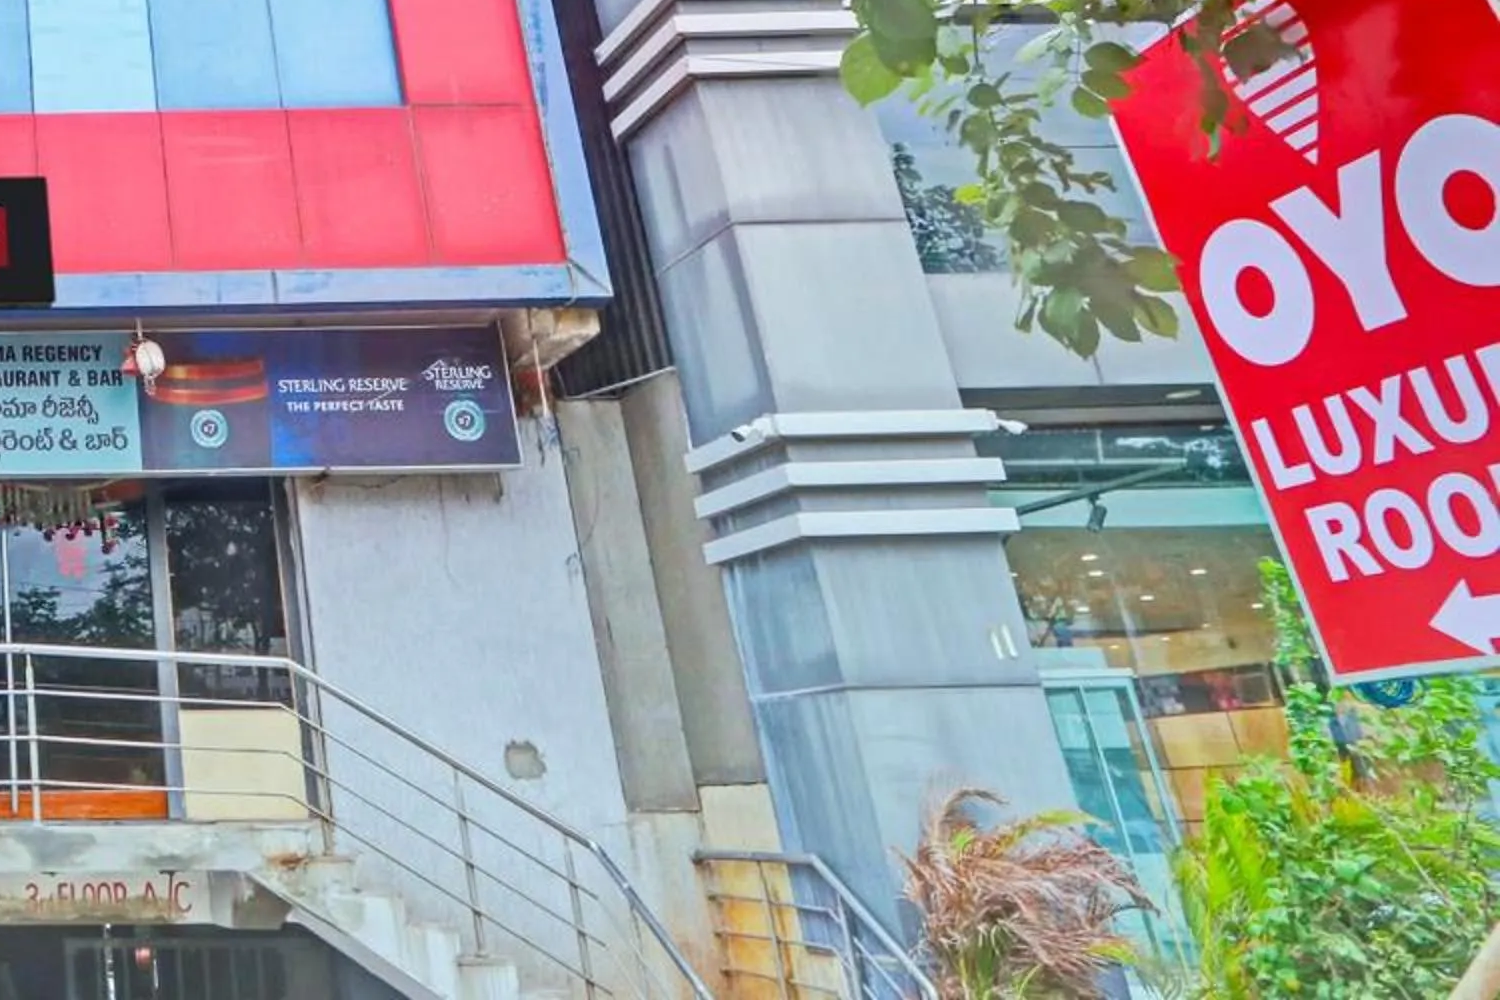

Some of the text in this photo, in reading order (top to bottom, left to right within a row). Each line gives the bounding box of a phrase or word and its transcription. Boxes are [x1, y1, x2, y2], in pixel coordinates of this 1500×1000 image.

[1200, 113, 1500, 367] OYO
[22, 345, 103, 362] REGENCY
[68, 370, 82, 386] &
[87, 369, 123, 386] BAR
[423, 365, 492, 380] STERLING
[278, 378, 408, 393] STERLING RESERVE
[287, 400, 404, 412] THE PERFECT TASTE
[59, 429, 77, 450] &
[1304, 461, 1500, 584] ROO
